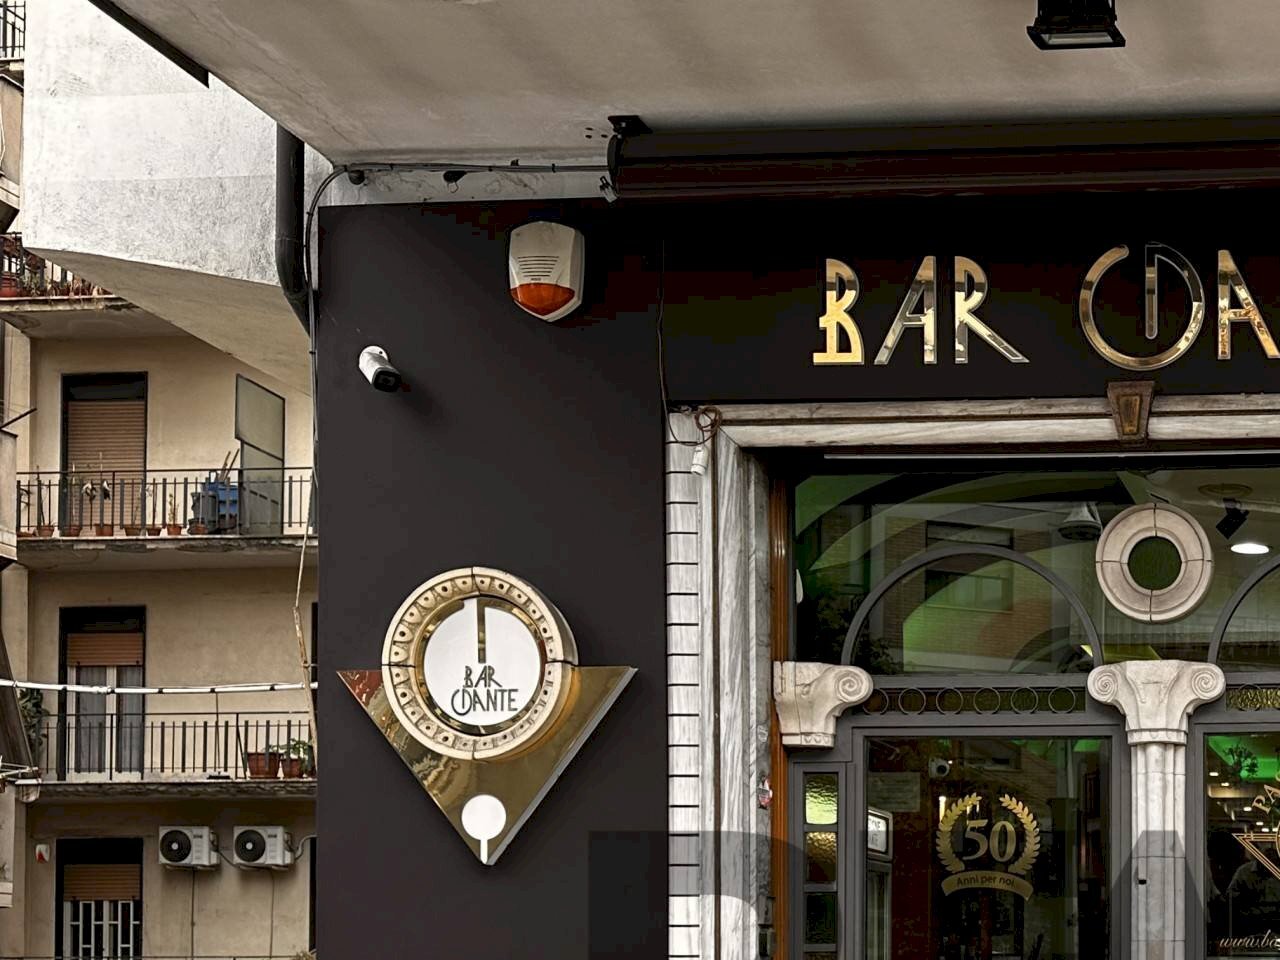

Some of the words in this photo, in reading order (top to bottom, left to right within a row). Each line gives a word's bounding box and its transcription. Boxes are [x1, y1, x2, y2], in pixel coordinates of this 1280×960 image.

[812, 255, 1029, 366] BAR
[462, 665, 503, 688] BAR
[451, 688, 519, 716] DANTE
[962, 819, 1017, 863] 50
[957, 874, 978, 887] Anni
[980, 874, 996, 885] per
